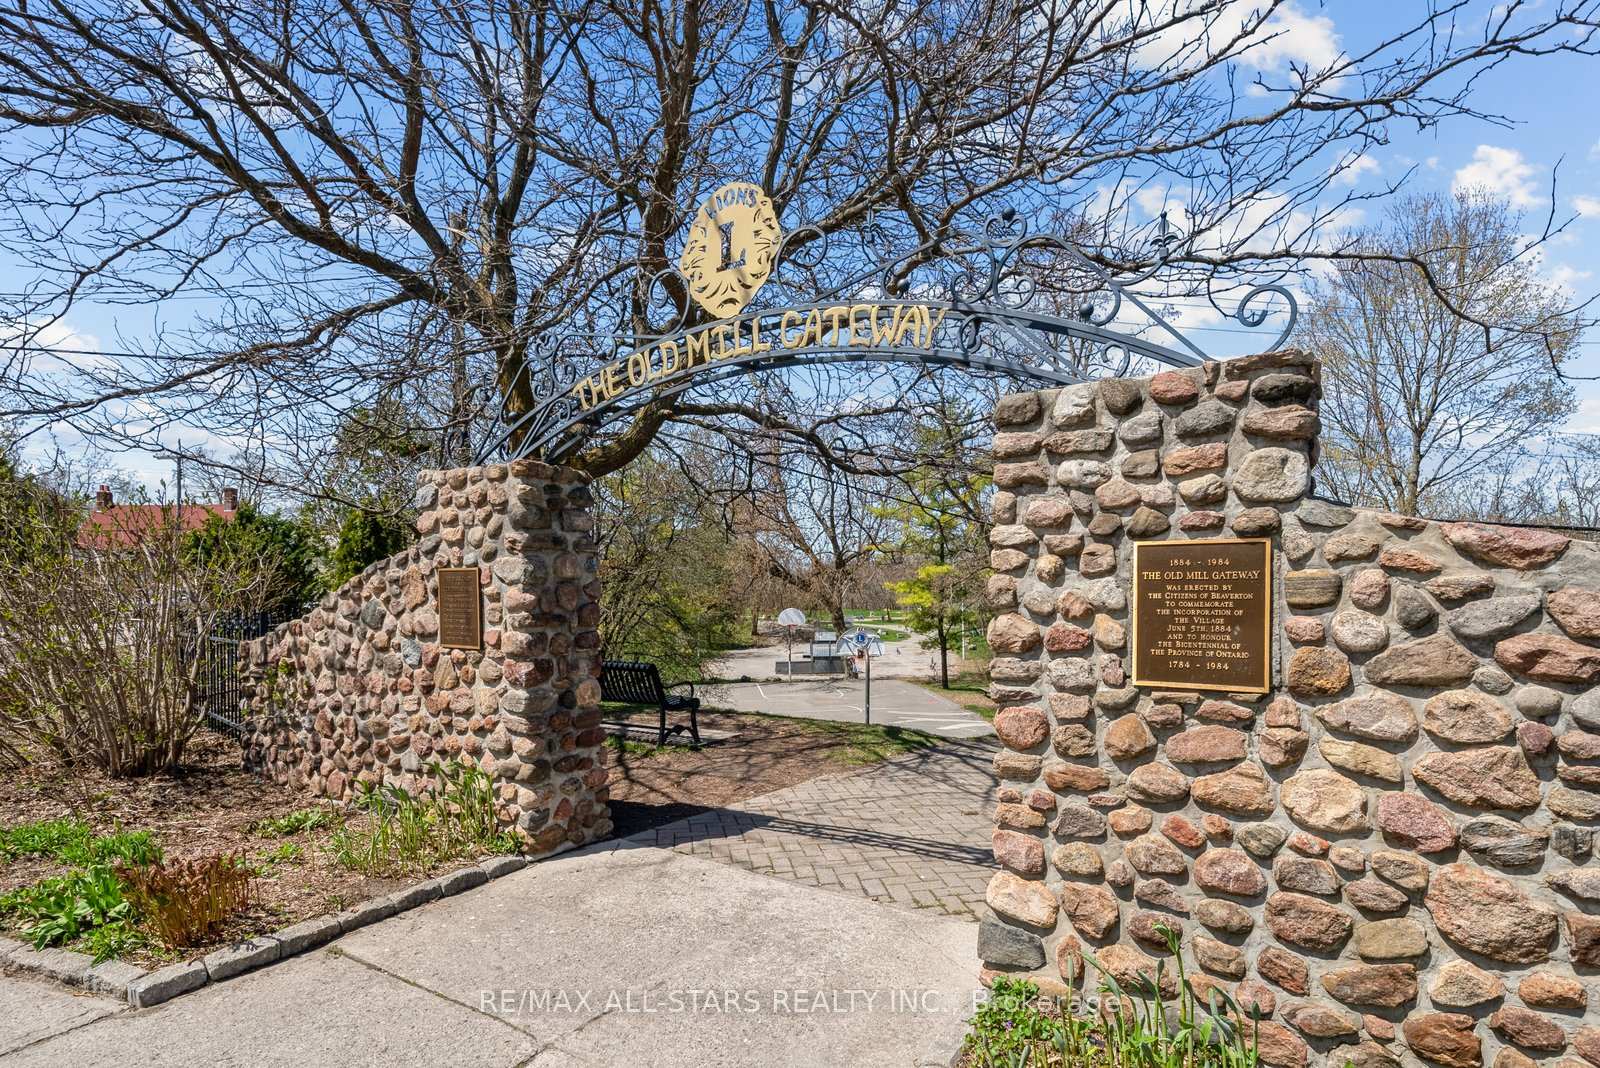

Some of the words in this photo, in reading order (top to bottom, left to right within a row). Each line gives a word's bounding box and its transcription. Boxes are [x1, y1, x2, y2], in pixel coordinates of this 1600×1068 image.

[716, 221, 746, 273] L
[571, 363, 624, 411] THE
[628, 341, 680, 387] OLD
[686, 318, 771, 368] MILL
[781, 304, 948, 349] GATEWAY
[1212, 570, 1260, 580] GATEWAY
[1176, 641, 1229, 649] BICENTENNIAL
[1216, 651, 1249, 659] ONTARIO
